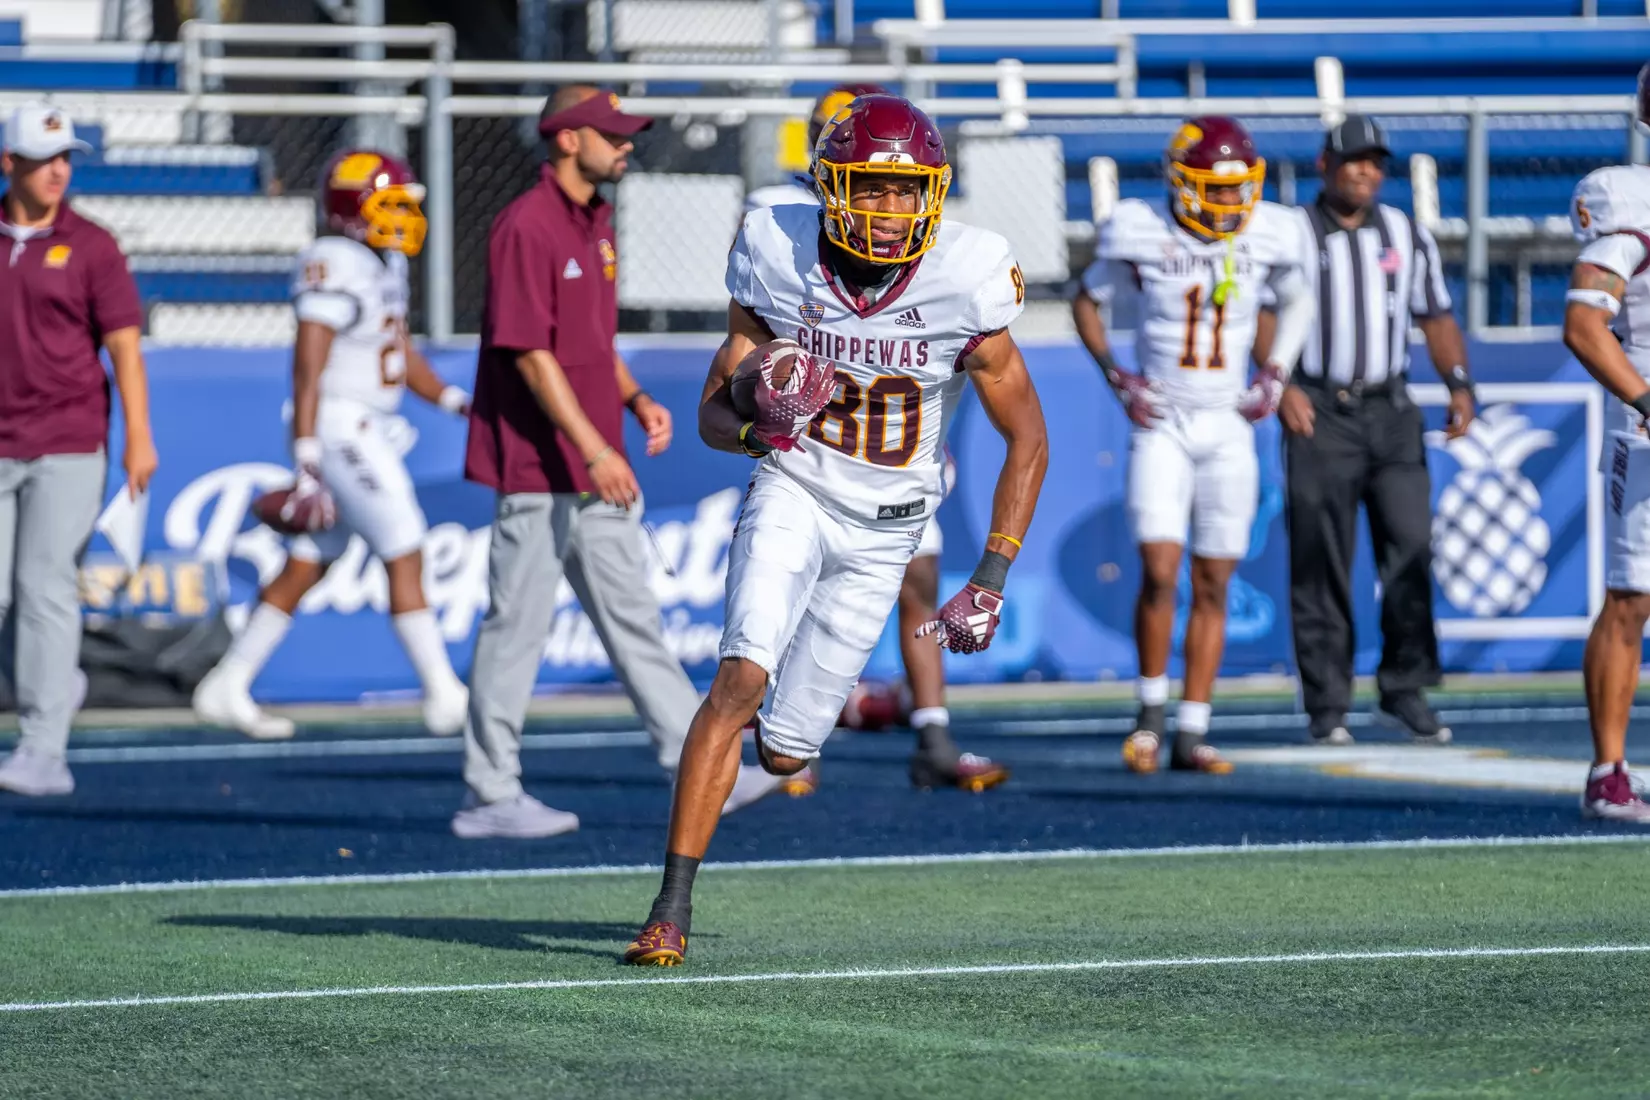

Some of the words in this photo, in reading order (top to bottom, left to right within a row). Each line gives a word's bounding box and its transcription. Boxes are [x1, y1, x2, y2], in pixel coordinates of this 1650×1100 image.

[797, 326, 930, 368] CHIPPEWAS
[894, 317, 926, 329] adidas
[1178, 283, 1226, 370] 11
[808, 370, 923, 468] 80
